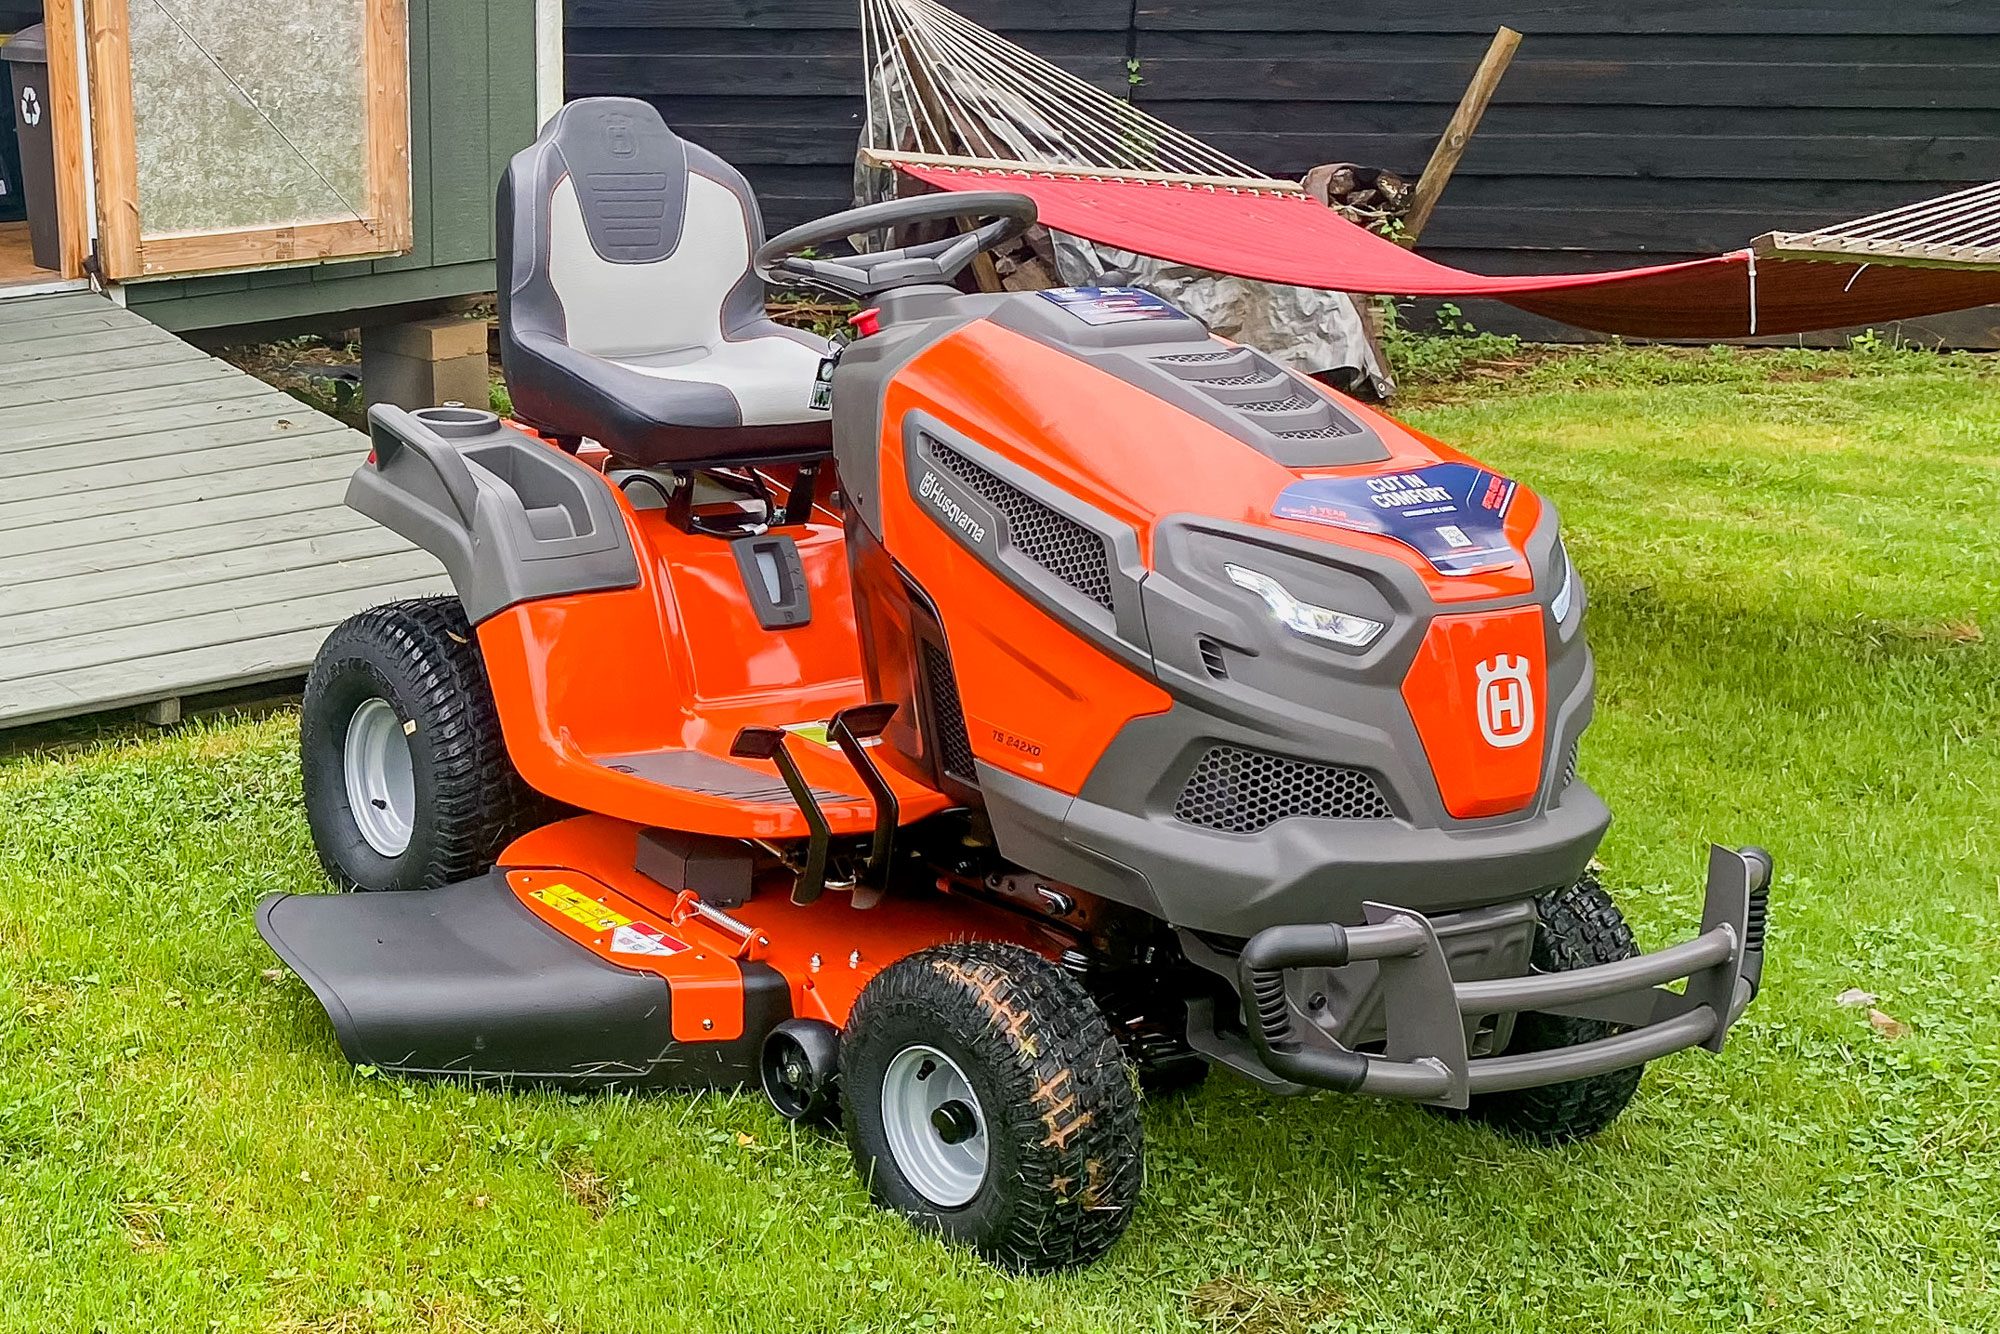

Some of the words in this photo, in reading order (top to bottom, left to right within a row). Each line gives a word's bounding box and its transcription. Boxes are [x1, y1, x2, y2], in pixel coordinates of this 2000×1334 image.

[1366, 475, 1406, 493] CUT
[1400, 473, 1428, 488] IN
[1370, 486, 1454, 508] COMFORT
[929, 482, 985, 543] Husqvarna
[992, 729, 1005, 743] TS
